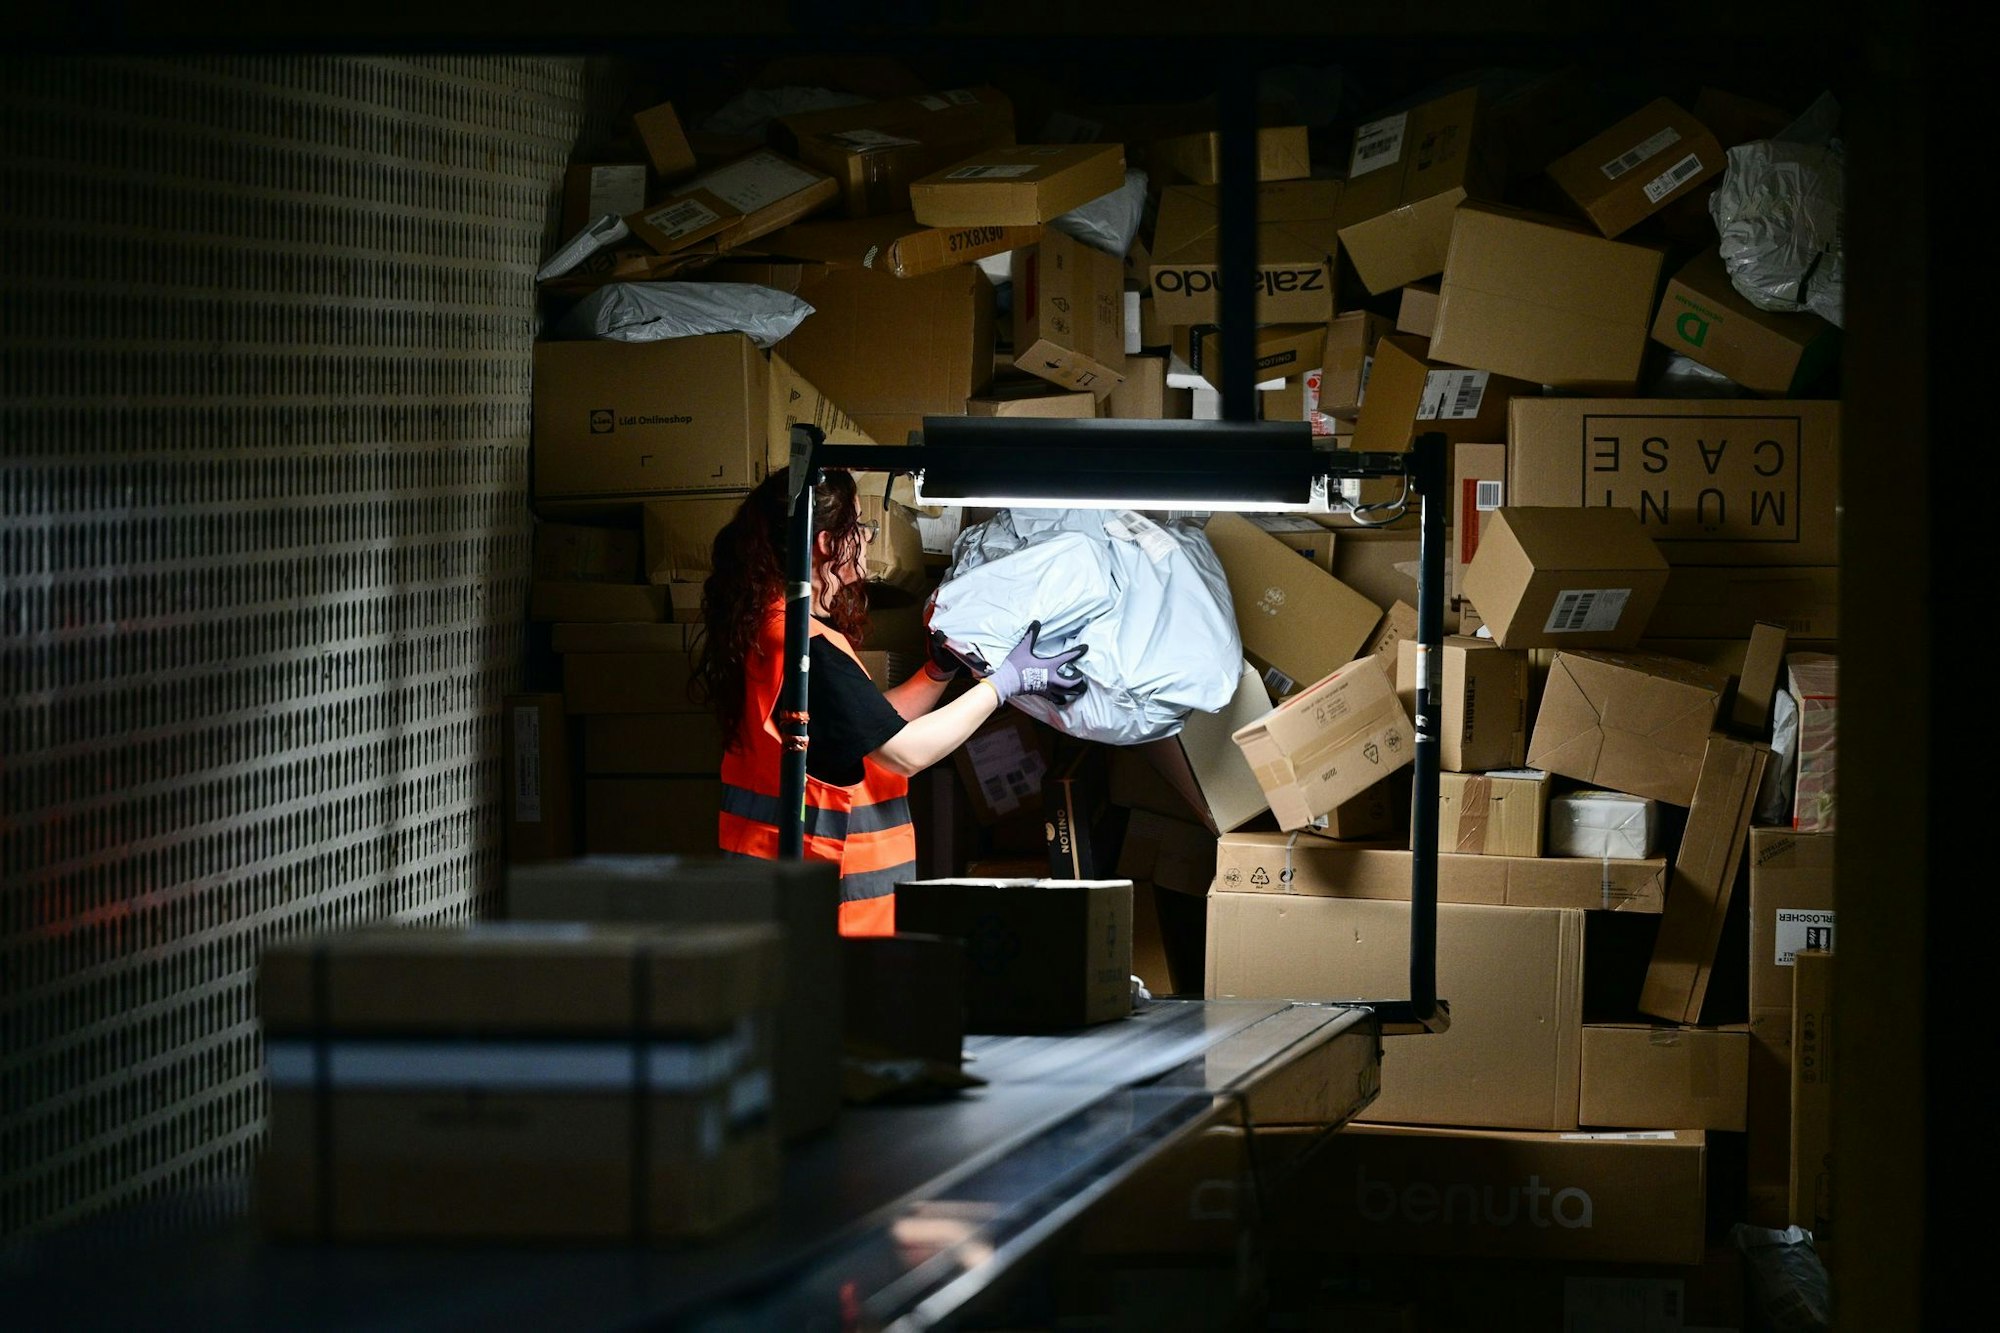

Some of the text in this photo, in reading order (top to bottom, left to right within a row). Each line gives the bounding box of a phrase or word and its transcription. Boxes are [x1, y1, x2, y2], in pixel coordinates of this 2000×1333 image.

[949, 226, 1004, 252] 37X8X90
[1677, 312, 1709, 348] D
[618, 414, 692, 426] Lidl Onlineshop
[1593, 437, 1784, 477] CASE
[1057, 808, 1071, 854] NOTINO
[1355, 1164, 1594, 1229] benuta
